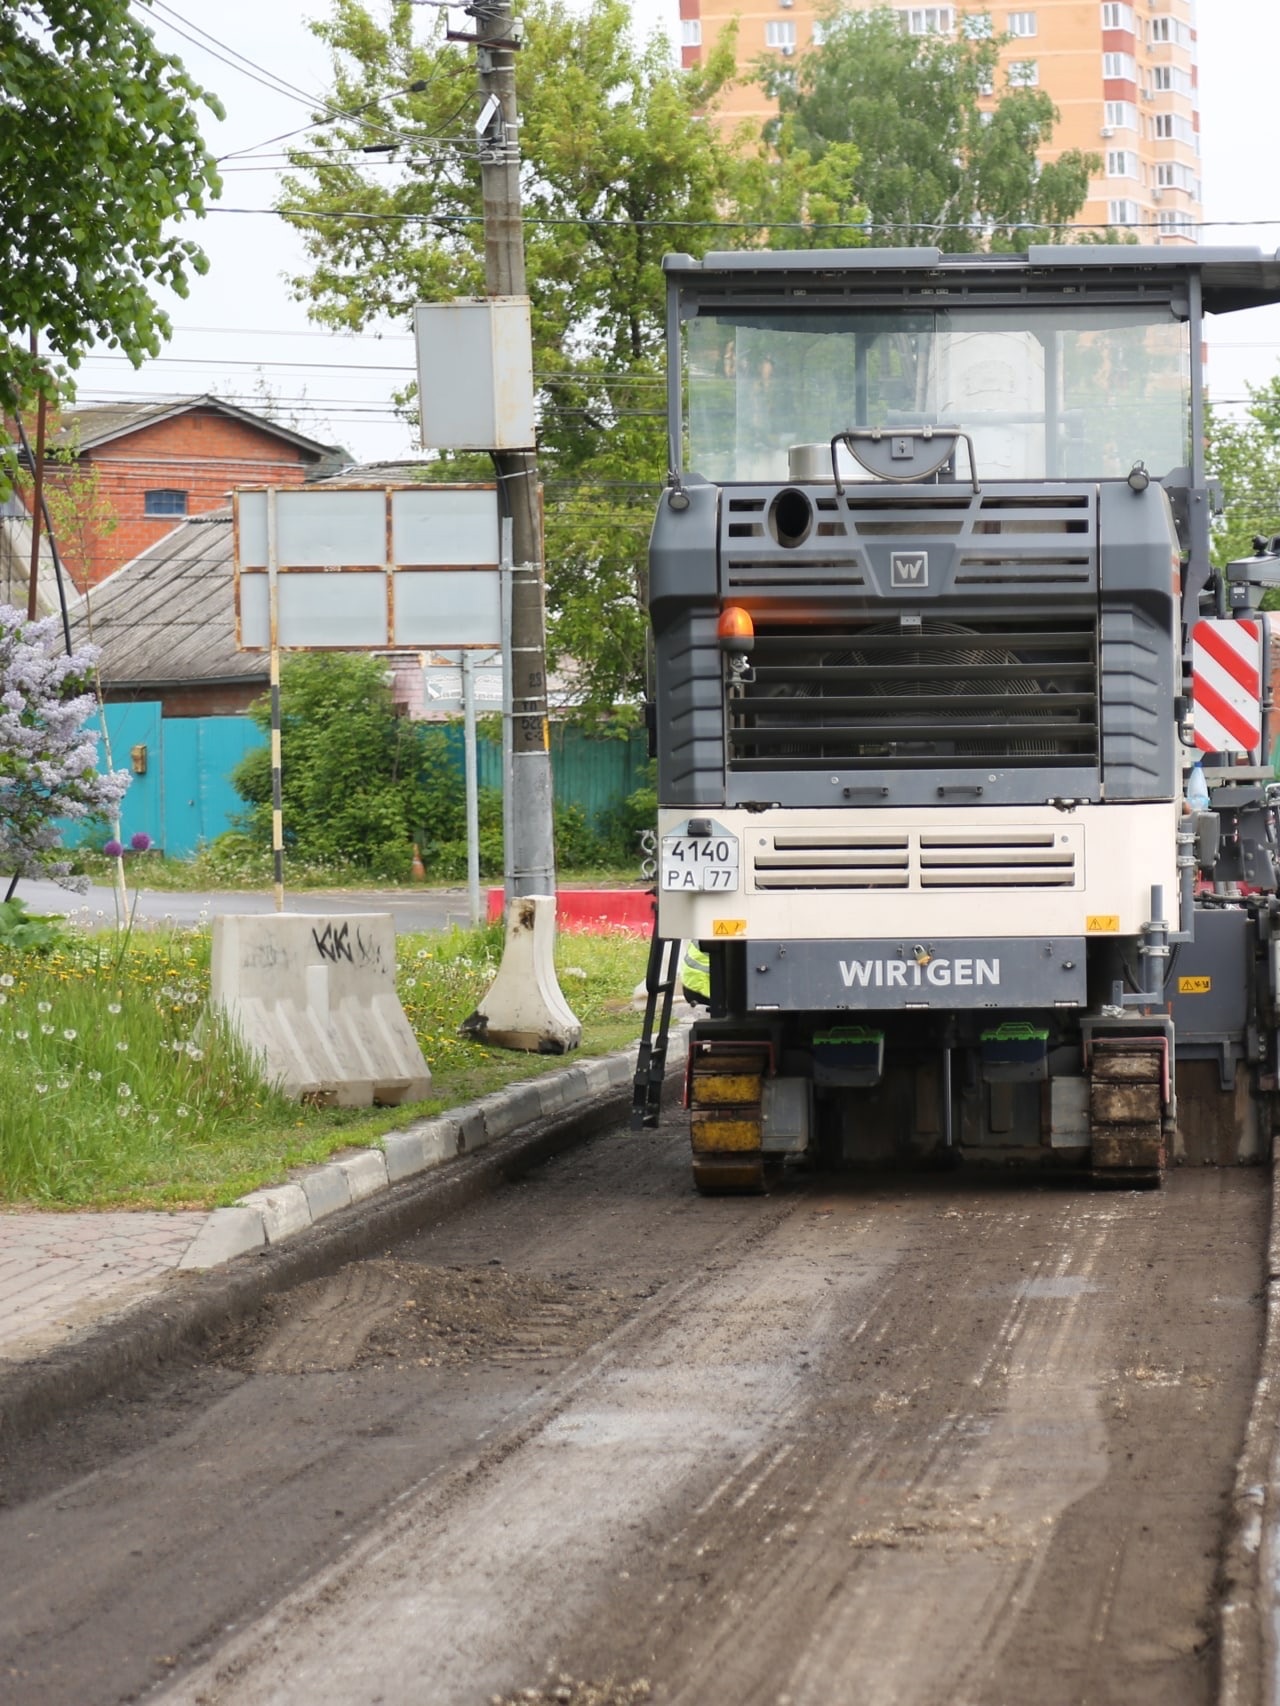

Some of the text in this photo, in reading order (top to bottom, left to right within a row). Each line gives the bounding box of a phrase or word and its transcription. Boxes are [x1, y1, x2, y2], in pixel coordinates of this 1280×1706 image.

[672, 840, 730, 862] 4140
[709, 870, 732, 887] 77
[838, 958, 1001, 987] WIRTGEN
